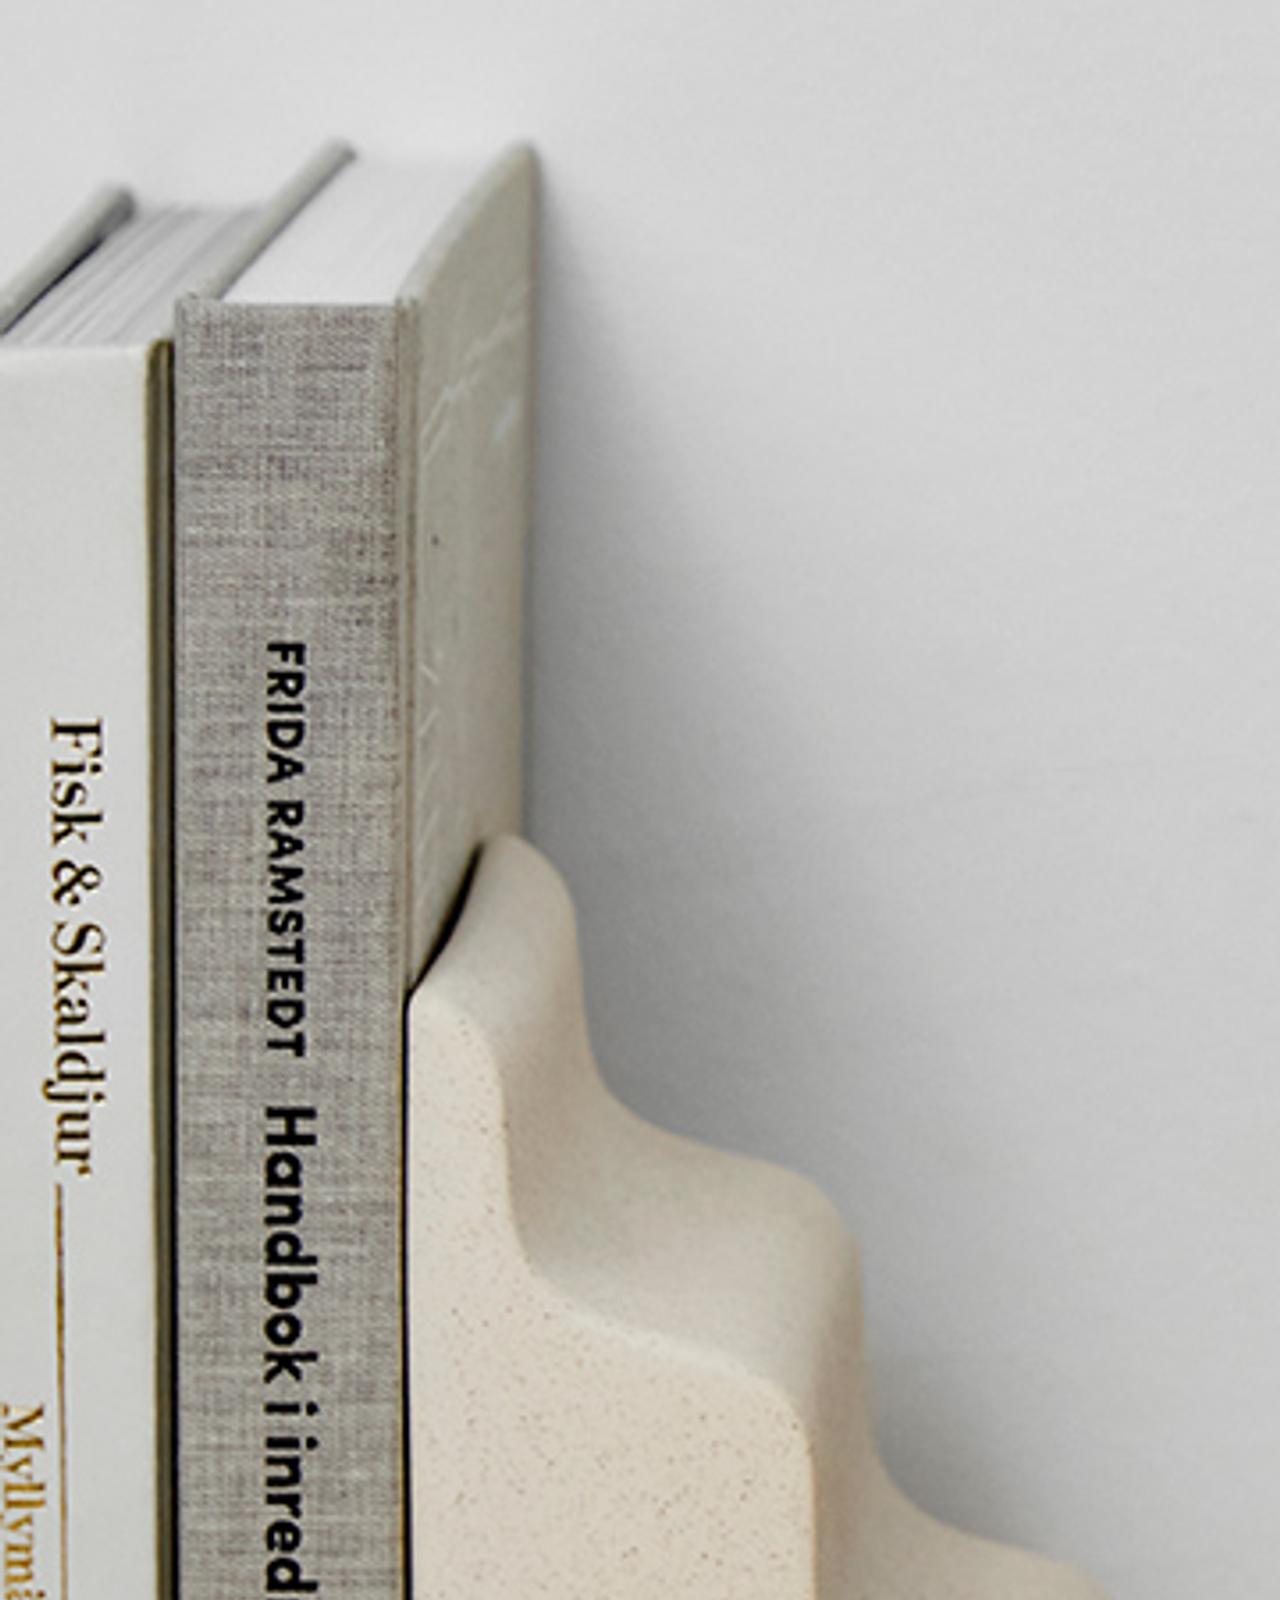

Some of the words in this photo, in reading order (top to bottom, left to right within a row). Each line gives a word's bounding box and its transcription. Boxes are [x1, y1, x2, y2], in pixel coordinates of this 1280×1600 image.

[51, 720, 103, 845] Fisk
[267, 643, 305, 783] FRIDA
[52, 860, 101, 906] &
[267, 801, 305, 1057] RAMSTEDT
[42, 922, 106, 1175] Skaldjur
[264, 1107, 318, 1383] Handbok
[265, 1402, 318, 1416] i
